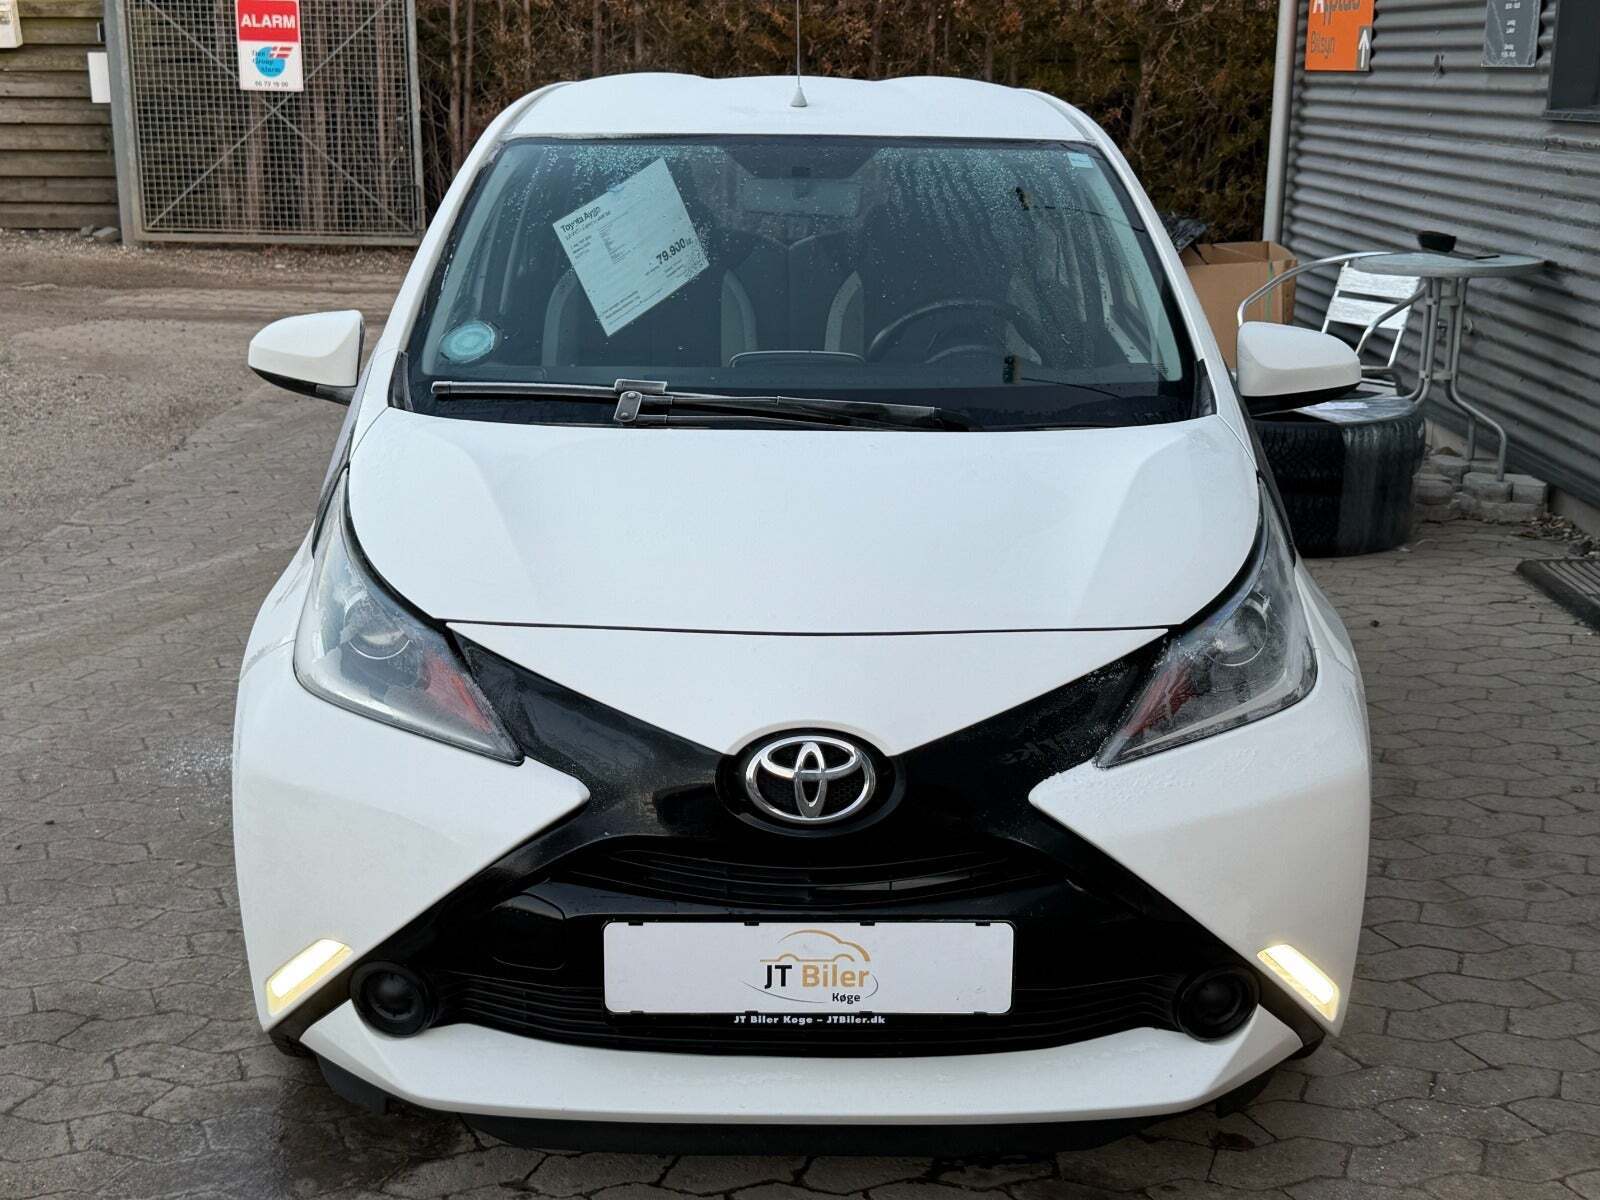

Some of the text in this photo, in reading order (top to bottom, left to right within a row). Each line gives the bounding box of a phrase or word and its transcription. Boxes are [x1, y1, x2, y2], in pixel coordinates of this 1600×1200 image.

[240, 14, 296, 28] ALARM
[1311, 31, 1335, 59] Bilsyn
[560, 215, 584, 232] Toyota
[656, 238, 686, 264] 79.900
[764, 963, 870, 989] JT Biler
[832, 992, 861, 1005] Køge
[733, 1015, 747, 1024] JT
[750, 1015, 779, 1024] Biler
[826, 1015, 886, 1024] JTBiler.dk
